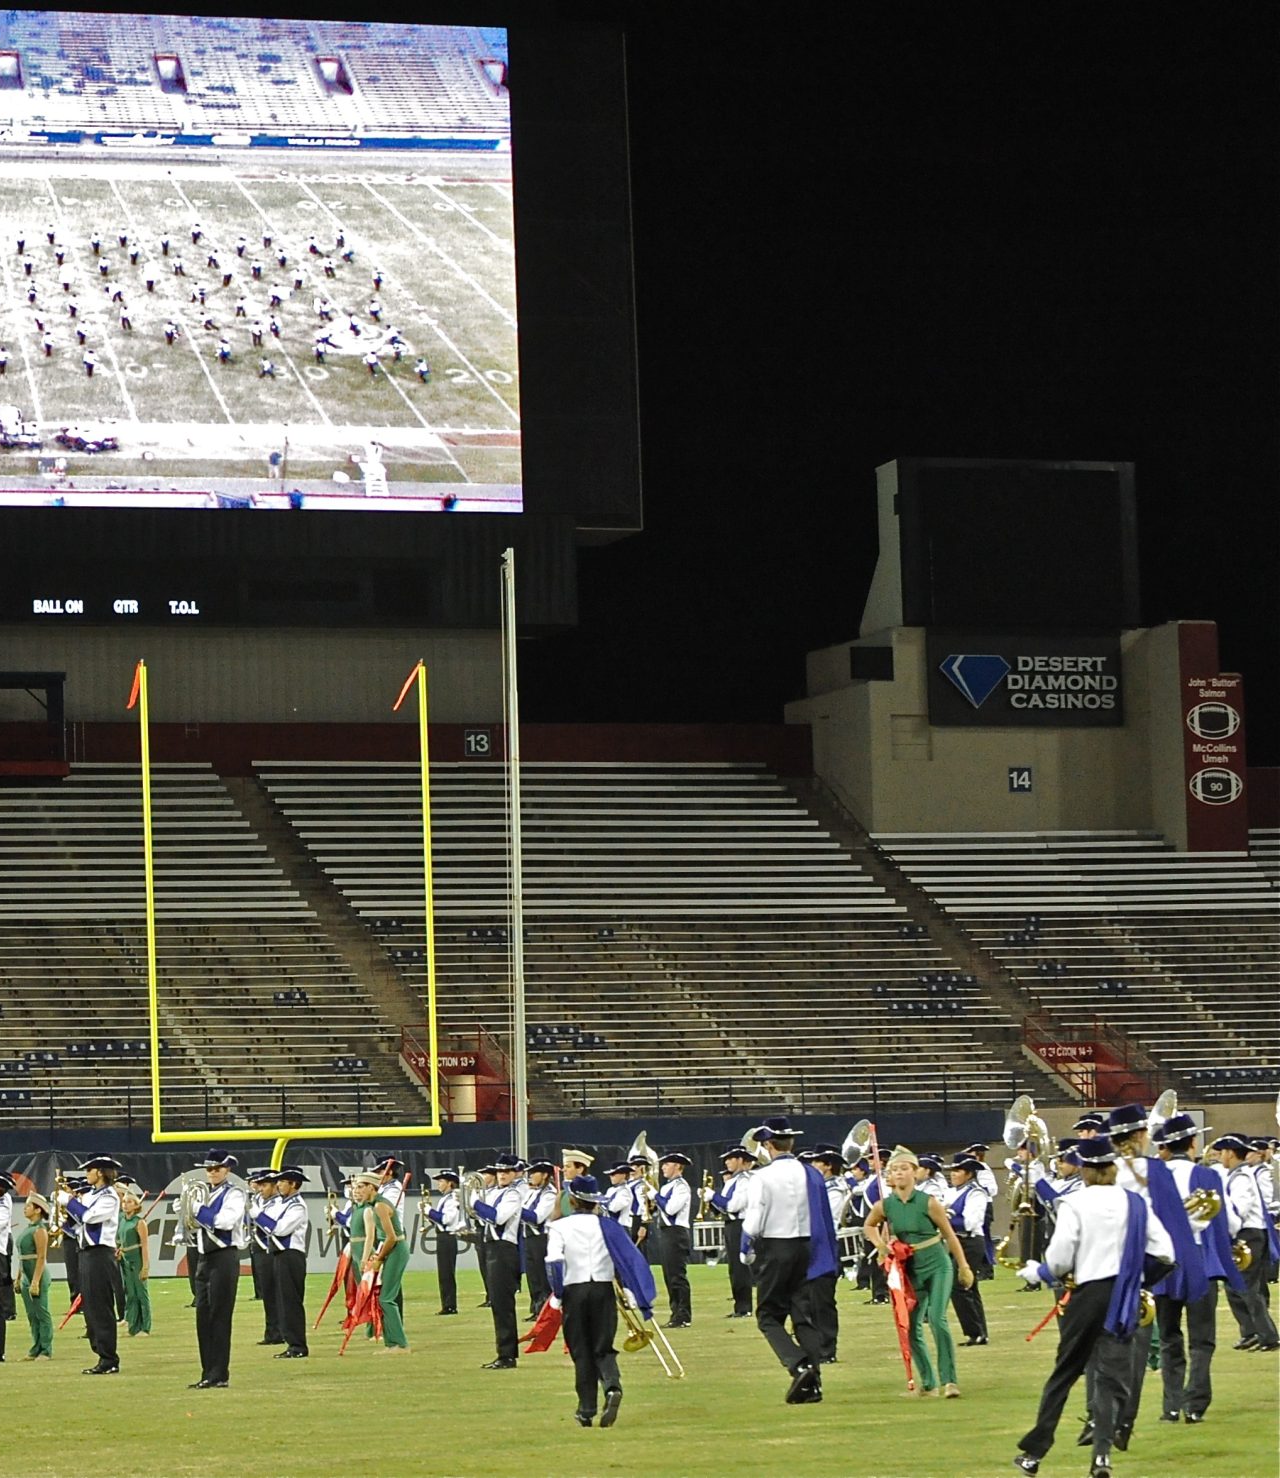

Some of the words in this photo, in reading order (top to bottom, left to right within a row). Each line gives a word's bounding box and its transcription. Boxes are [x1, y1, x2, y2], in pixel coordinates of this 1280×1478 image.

[33, 600, 64, 613] BALL
[65, 600, 83, 613] ON
[113, 600, 138, 613] QTR
[1017, 656, 1107, 672] DESERT
[1007, 674, 1118, 691] DIAMOND
[1188, 678, 1206, 687] John
[1199, 688, 1226, 698] Salmon
[1010, 693, 1116, 709] CASINOS
[466, 734, 489, 752] 13
[1192, 743, 1237, 753] McCollins
[1202, 754, 1229, 764] Umeh
[1009, 771, 1031, 788] 14
[1210, 782, 1223, 791] 90
[460, 1056, 468, 1067] 13
